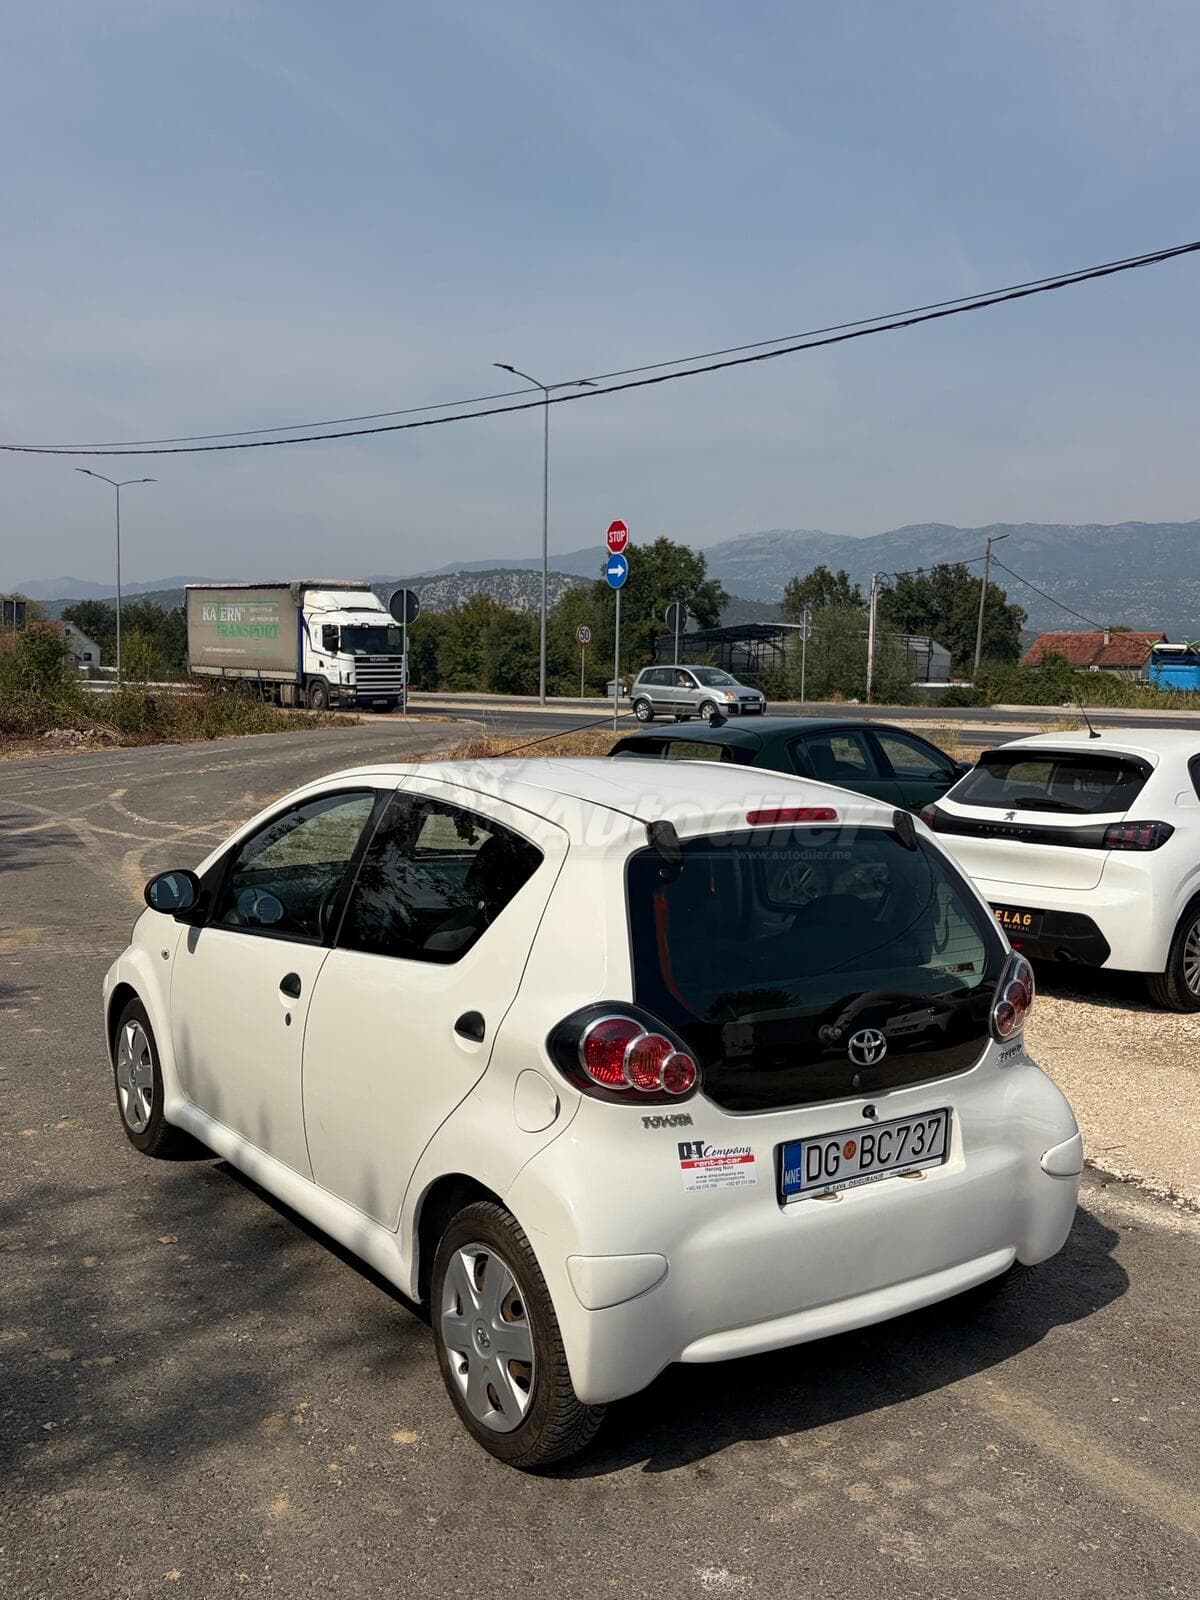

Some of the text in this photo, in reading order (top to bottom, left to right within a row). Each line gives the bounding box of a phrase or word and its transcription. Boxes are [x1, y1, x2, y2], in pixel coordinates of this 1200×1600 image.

[608, 530, 626, 543] STOP
[580, 629, 590, 641] 50
[641, 1112, 694, 1130] TOYOTA
[704, 1145, 752, 1158] Company
[806, 1117, 942, 1182] DG BC737
[693, 1157, 742, 1168] rent-a-car
[784, 1167, 801, 1186] MNE
